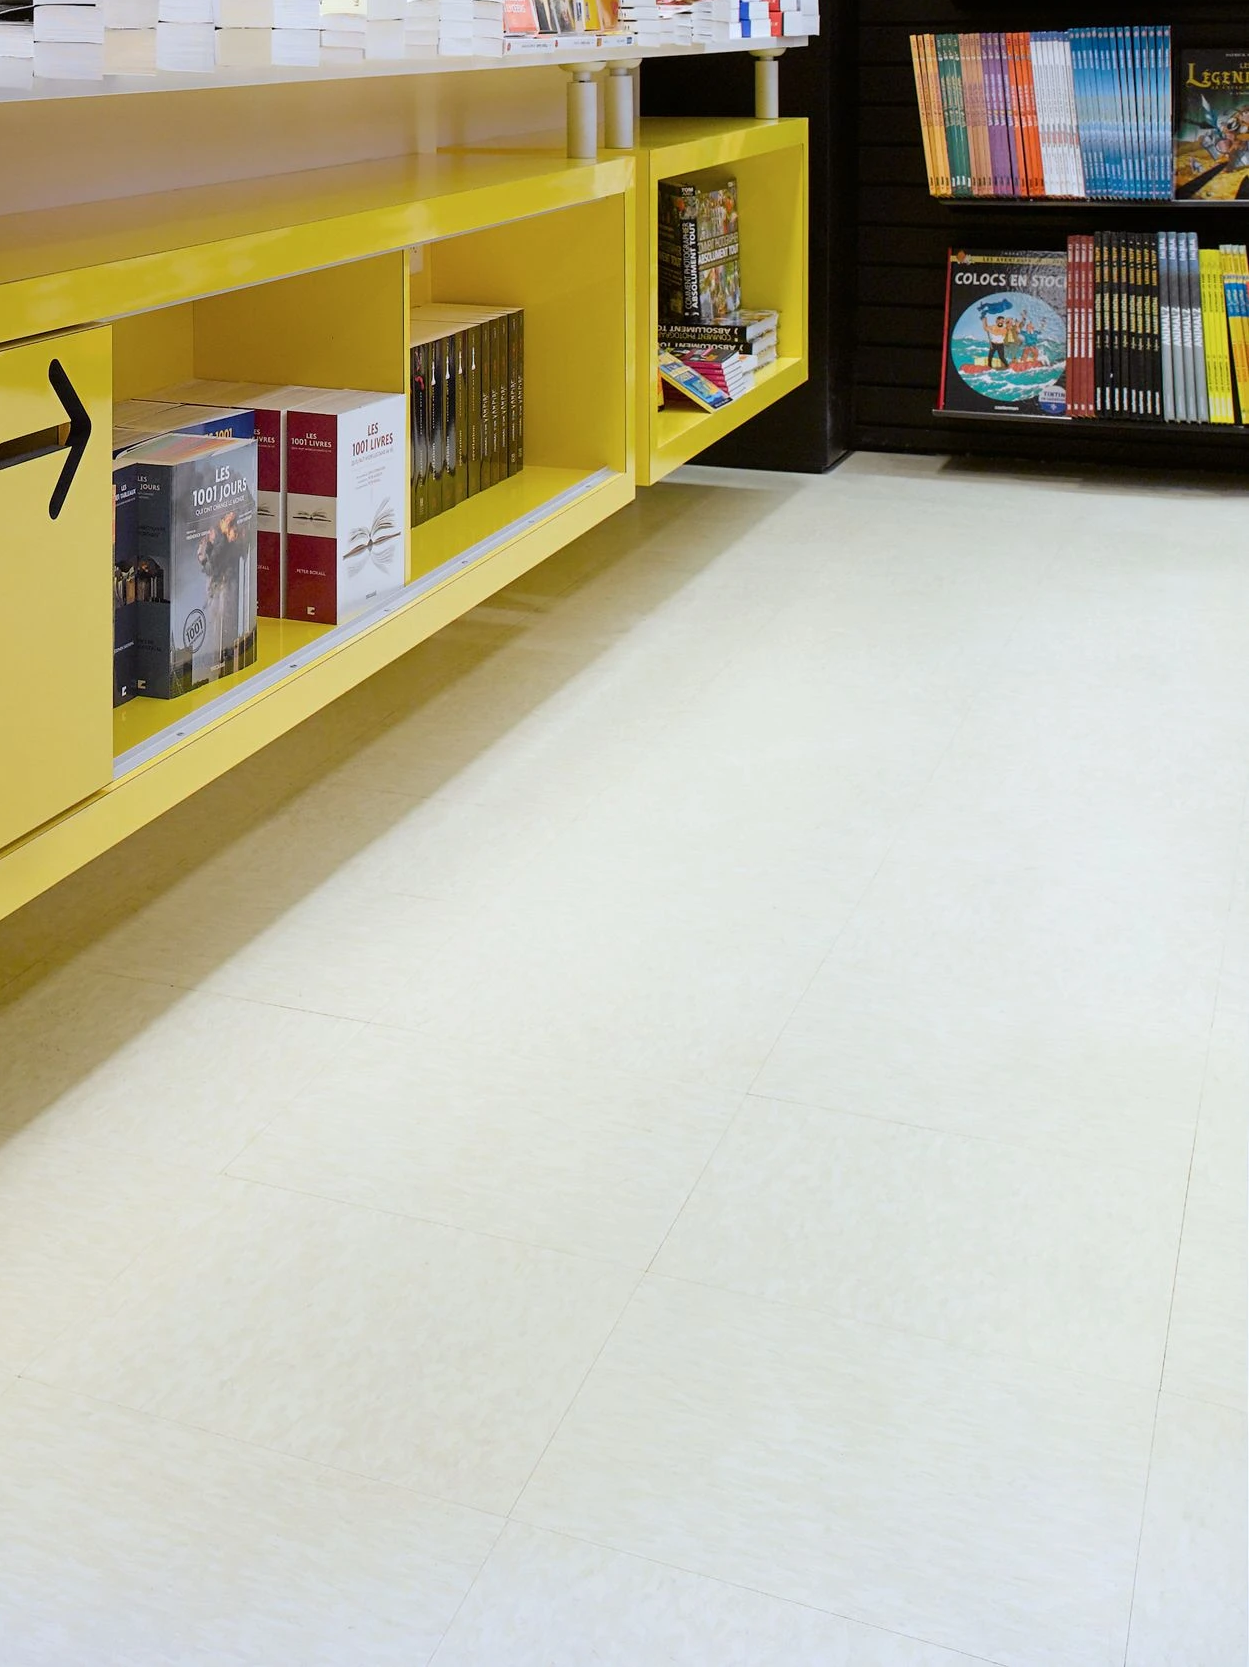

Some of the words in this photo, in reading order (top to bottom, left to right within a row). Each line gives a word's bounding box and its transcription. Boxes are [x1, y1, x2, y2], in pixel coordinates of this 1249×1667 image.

[690, 249, 698, 308] ABSOLUMENT
[955, 272, 1006, 285] COLOCS
[1010, 274, 1027, 286] EN
[367, 422, 379, 437] LES
[291, 438, 307, 446] 1001
[309, 440, 332, 448] LIVRES
[352, 439, 369, 457] 1001
[370, 433, 393, 450] LIVRES
[137, 475, 148, 483] LES
[215, 465, 230, 483] LES
[192, 486, 218, 507] 1001
[218, 477, 247, 502] JOURS
[204, 505, 213, 514] ONT
[186, 620, 203, 643] 1001
